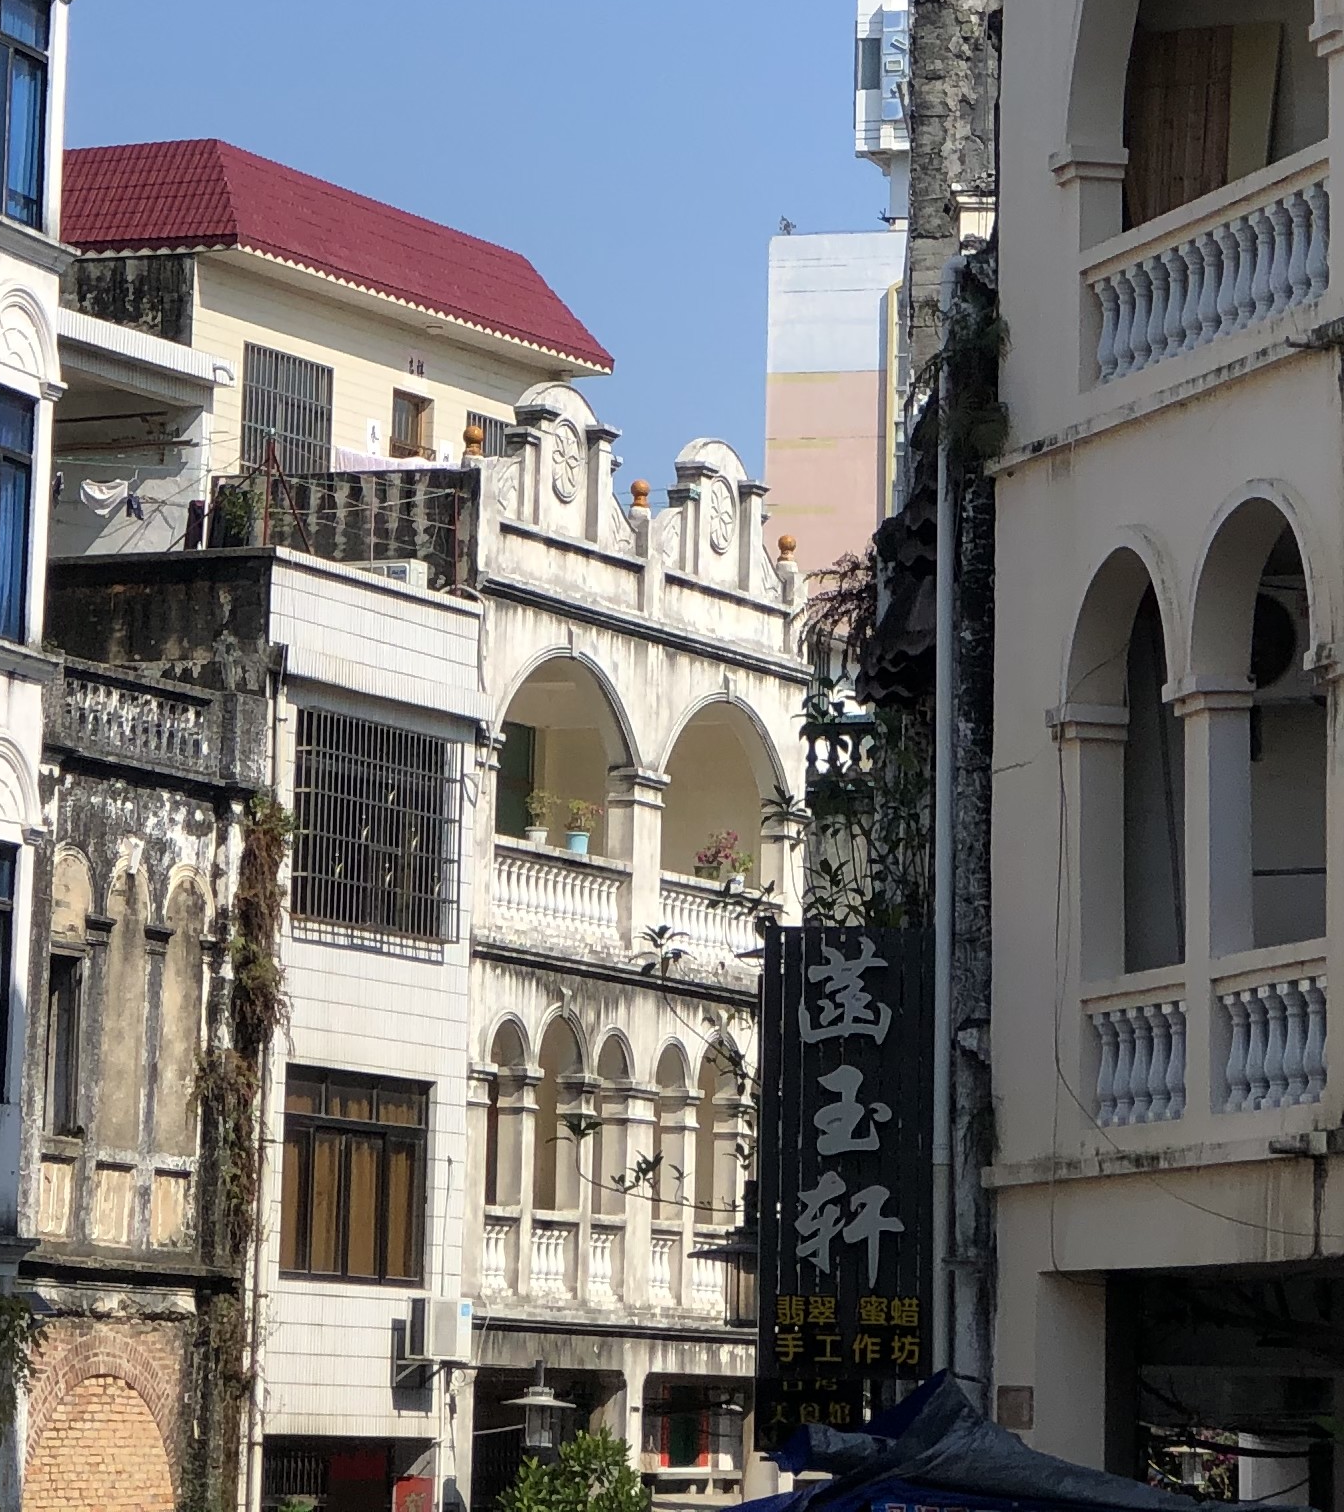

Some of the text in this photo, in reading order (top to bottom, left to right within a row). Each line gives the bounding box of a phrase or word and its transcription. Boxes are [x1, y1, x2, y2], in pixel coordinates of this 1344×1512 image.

[775, 1295, 921, 1327] 翡翠 蜜蜡
[774, 1332, 921, 1365] 手工作坊
